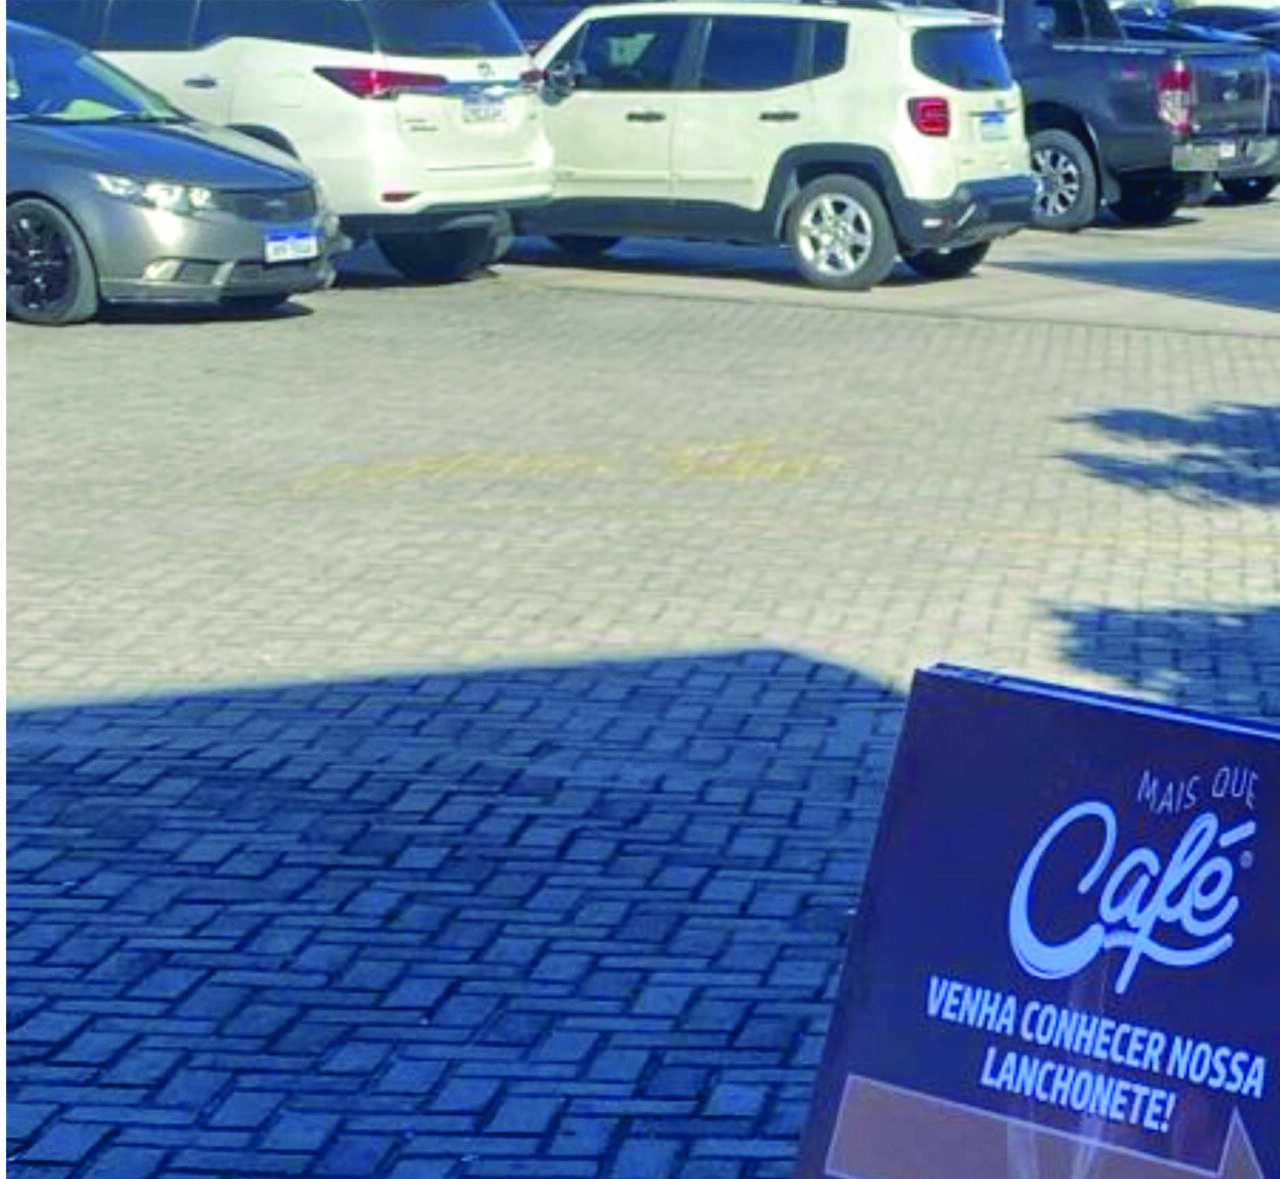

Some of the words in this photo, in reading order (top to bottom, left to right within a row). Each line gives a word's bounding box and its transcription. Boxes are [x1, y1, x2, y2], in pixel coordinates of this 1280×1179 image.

[1138, 769, 1200, 815] MAIS
[1211, 767, 1258, 809] QUE
[1009, 801, 1256, 993] Café
[926, 975, 1017, 1035] VENHA
[1020, 1001, 1167, 1073] CONHECER
[1167, 1036, 1267, 1098] NOSSA
[980, 1047, 1177, 1133] LANCHONETE!
